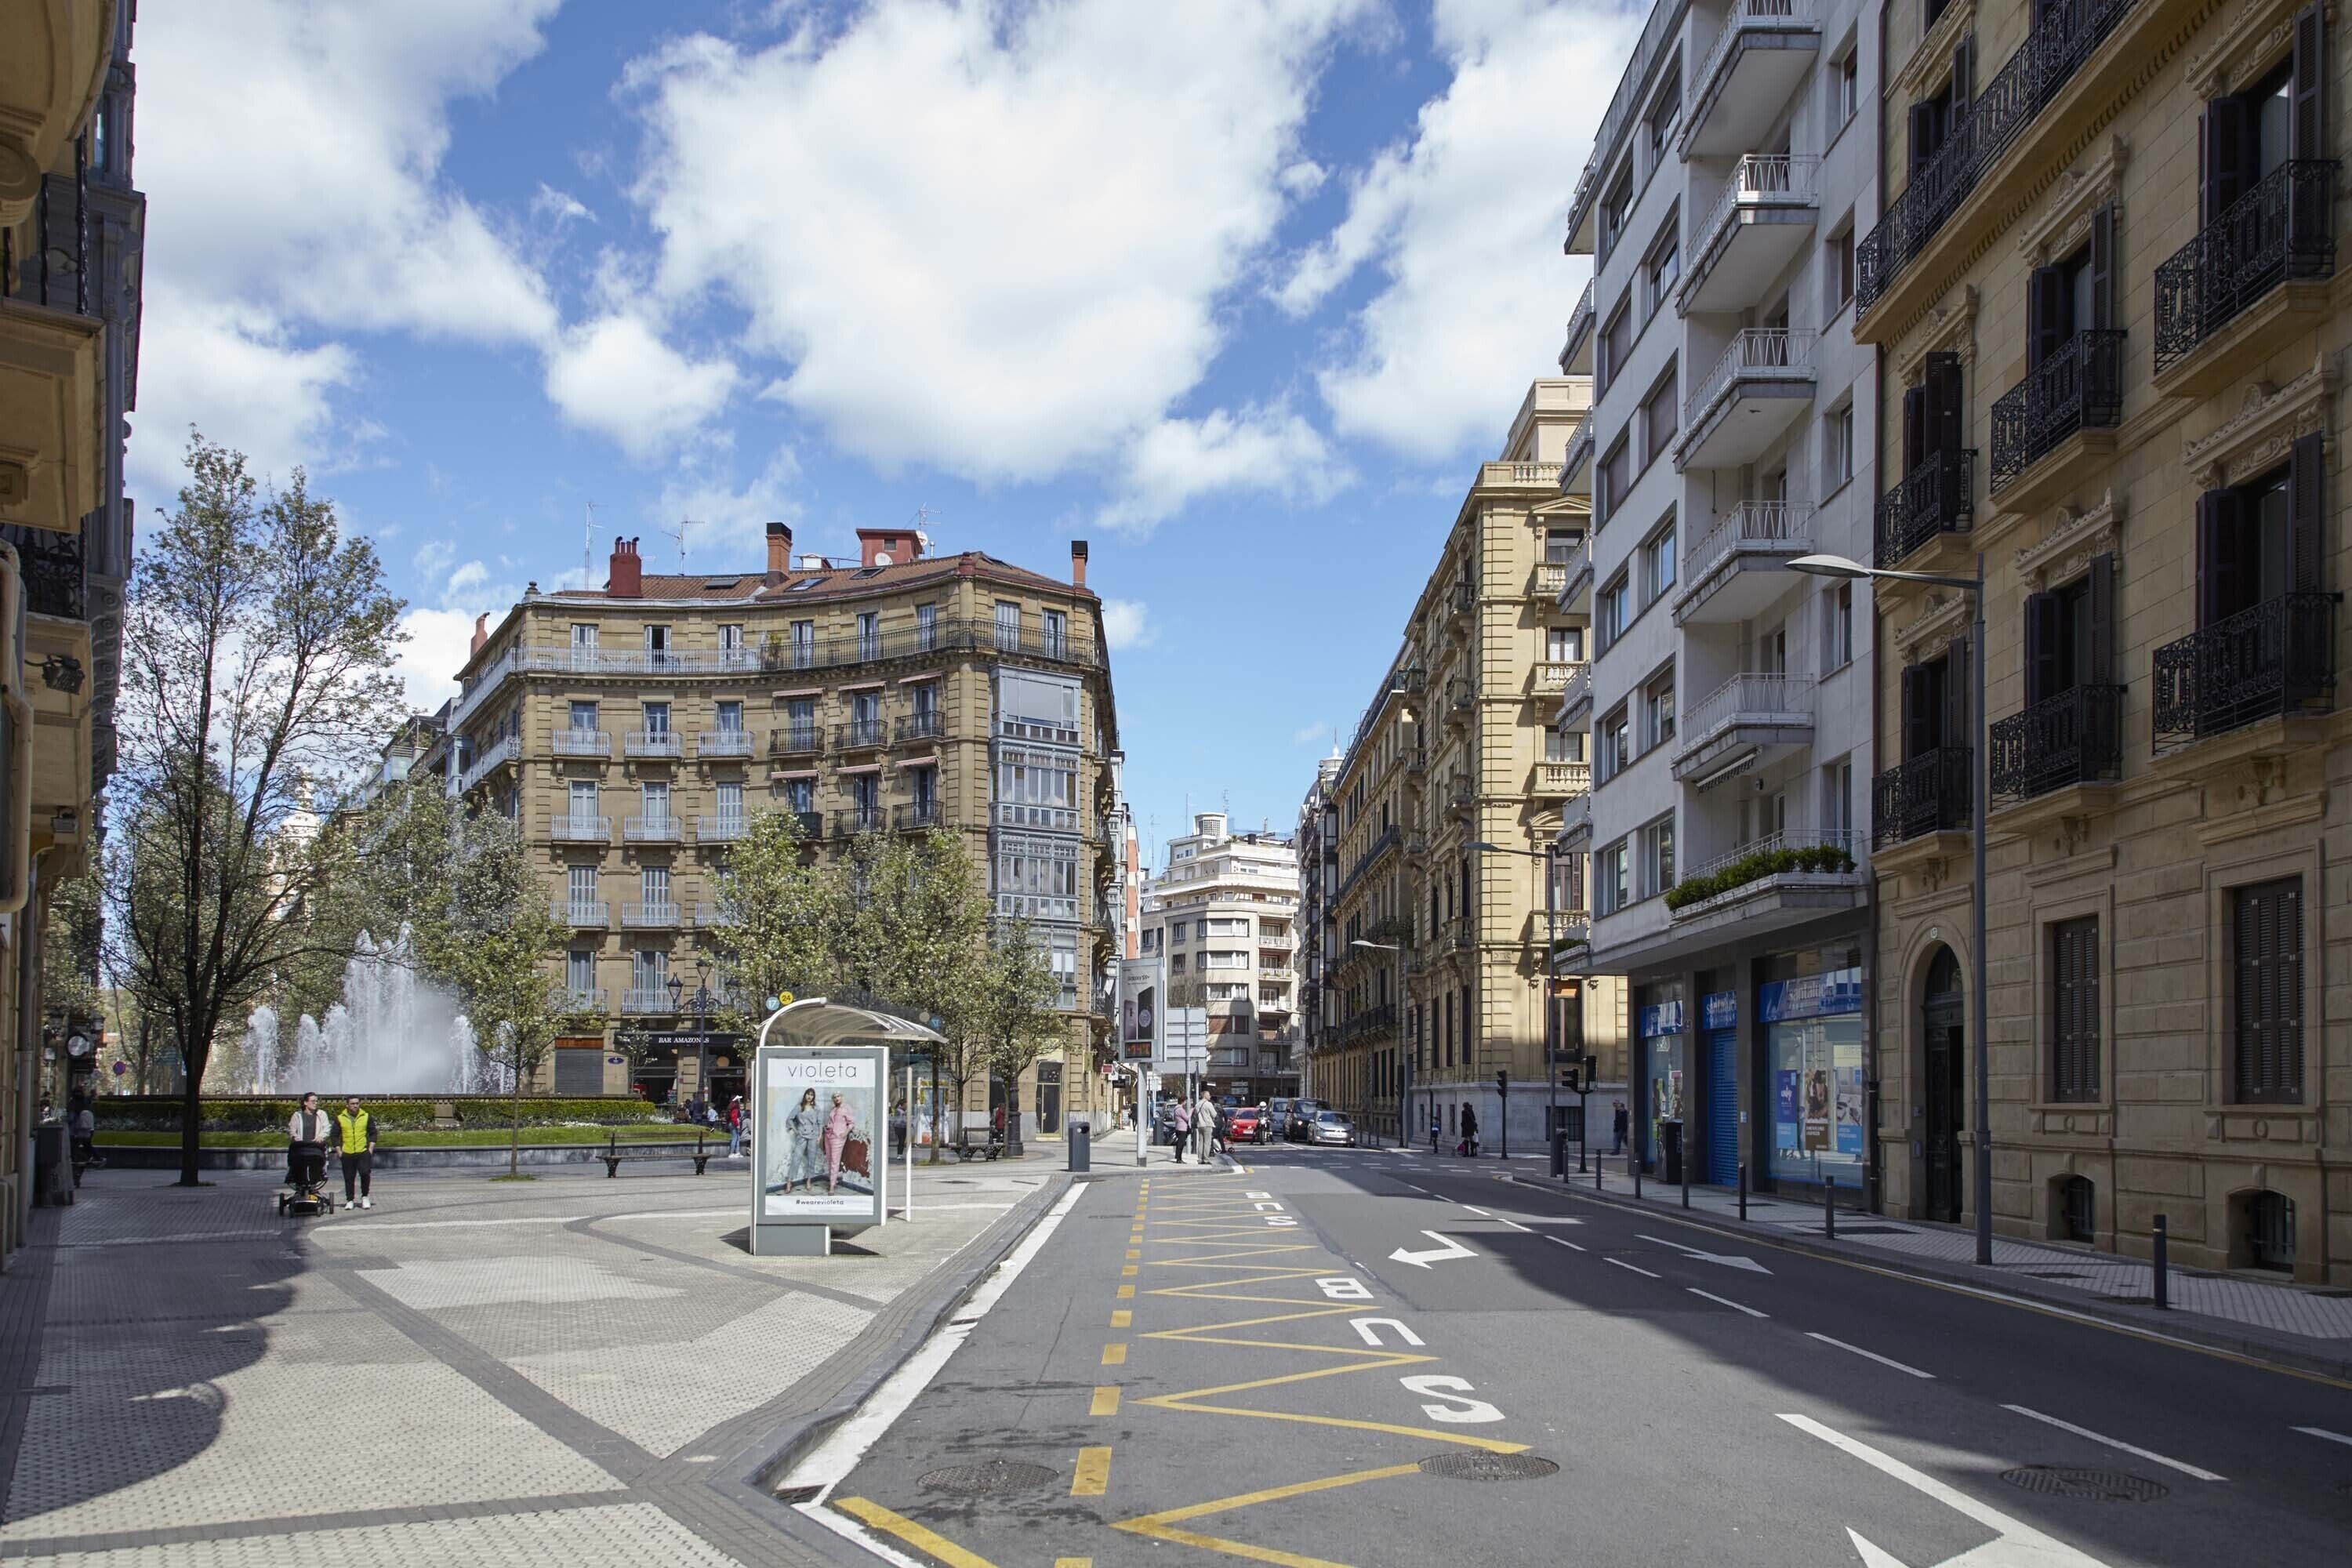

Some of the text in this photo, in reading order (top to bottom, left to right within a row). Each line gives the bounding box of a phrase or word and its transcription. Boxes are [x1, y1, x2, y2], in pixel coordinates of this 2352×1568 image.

[768, 1000, 777, 1009] 17
[787, 1062, 856, 1078] violeta
[1246, 1192, 1298, 1226] BUS
[1315, 1278, 1505, 1423] BUS
